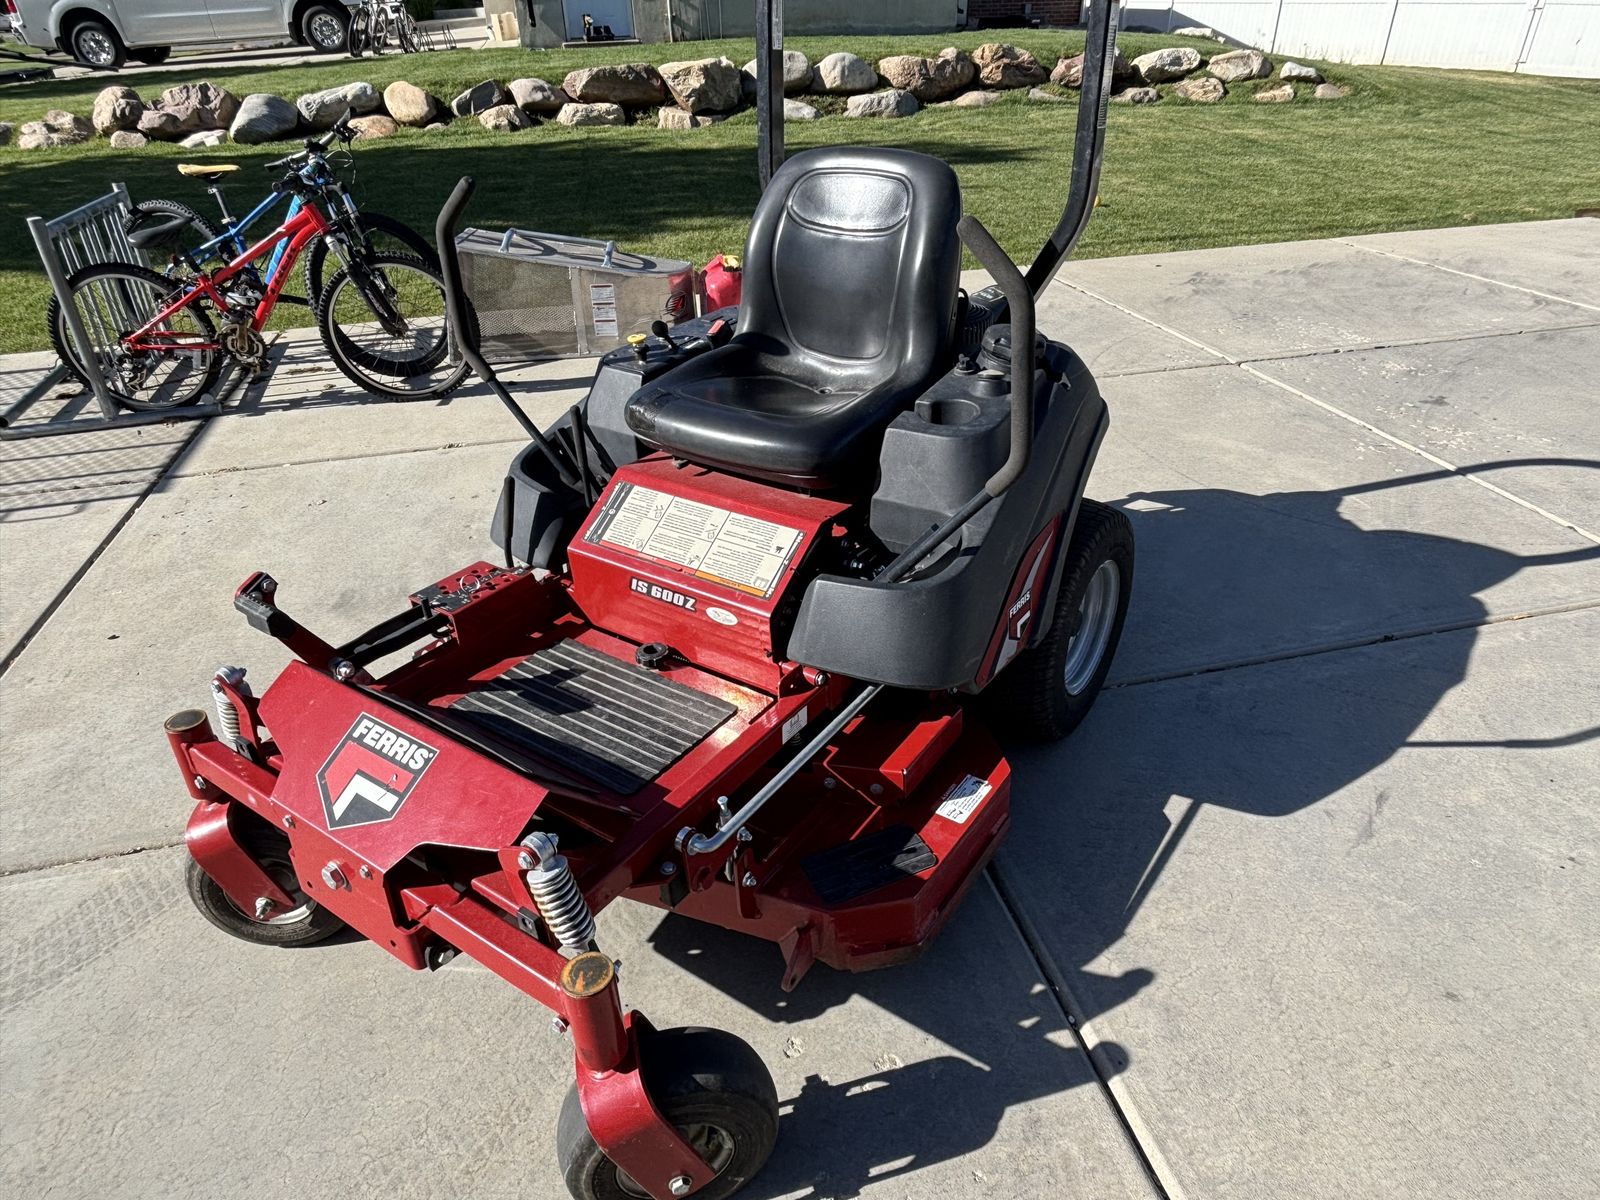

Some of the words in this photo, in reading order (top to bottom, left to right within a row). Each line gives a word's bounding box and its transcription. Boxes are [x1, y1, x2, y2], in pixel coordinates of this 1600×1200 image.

[631, 578, 649, 594] IS
[651, 585, 696, 611] 600Z
[1009, 591, 1031, 619] FERRIS
[352, 718, 430, 770] FERRIS
